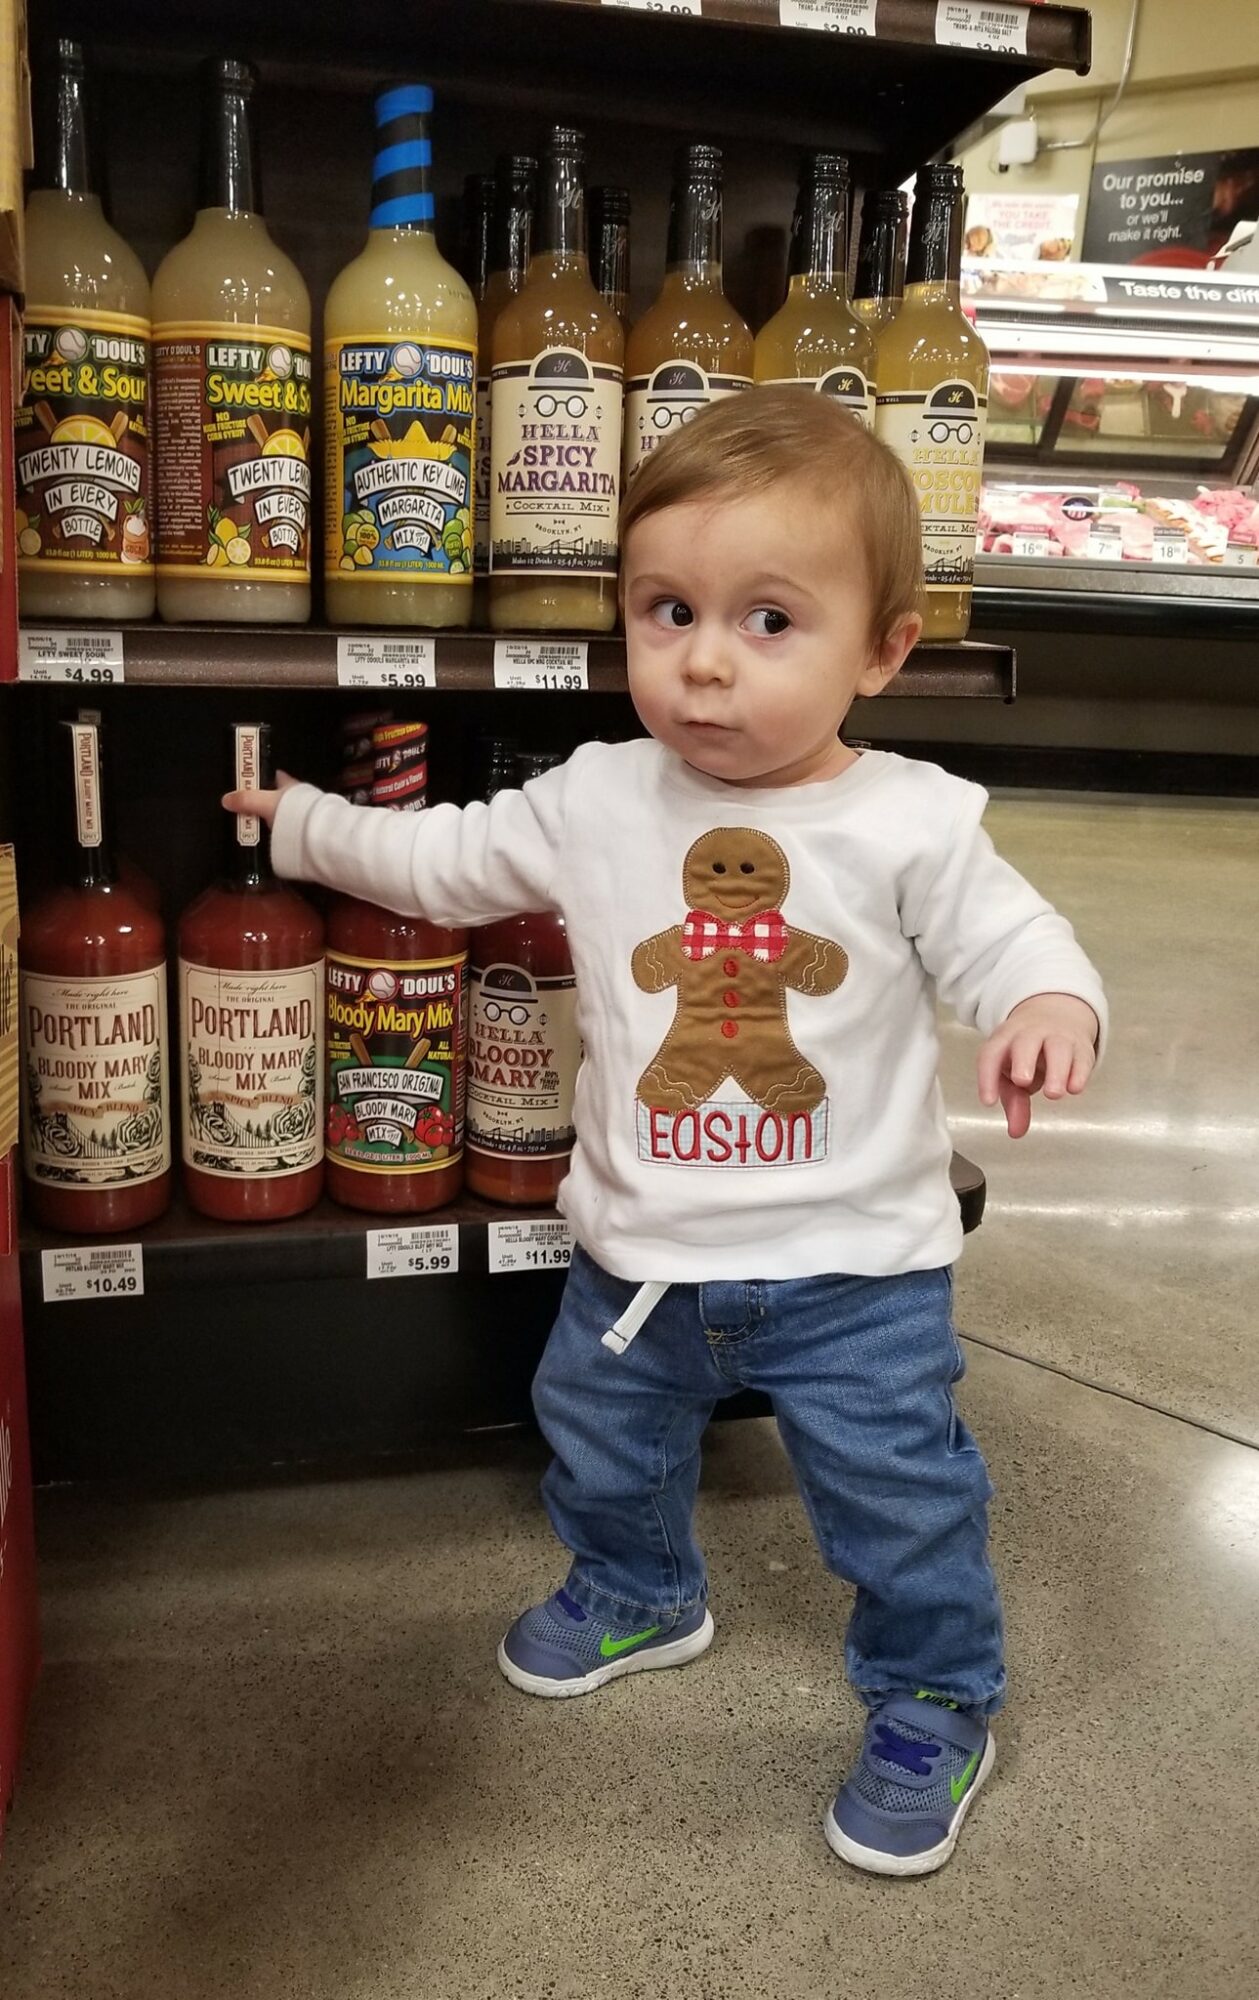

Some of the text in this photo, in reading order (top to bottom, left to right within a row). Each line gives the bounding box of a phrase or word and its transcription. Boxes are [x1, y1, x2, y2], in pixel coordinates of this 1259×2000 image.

[1102, 167, 1205, 191] Our promise
[1120, 192, 1184, 211] to you...
[1126, 211, 1168, 225] or we'll
[1107, 226, 1182, 242] make it right.
[1118, 281, 1181, 299] Taste
[1184, 286, 1221, 301] the
[208, 347, 261, 369] LEFTY
[341, 352, 385, 371] LEFTY
[24, 365, 146, 400] eet & Sour
[208, 374, 298, 412] Sweet &
[341, 379, 473, 414] Margarita Mix
[521, 424, 601, 442] HELLA
[20, 447, 138, 486] TWENTY LEMONS
[523, 445, 597, 467] SPICY
[229, 460, 284, 490] TWENTY
[356, 462, 465, 496] AUTHENTIC KEY LIME
[498, 471, 616, 496] MARGARITA
[48, 484, 116, 511] IN EVERY
[258, 495, 305, 522] IN EVERY
[513, 500, 575, 511] COCKTAIL
[382, 498, 442, 525] MARGARITA
[64, 518, 100, 536] BOTTLE
[272, 527, 298, 545] BOTTLE
[395, 529, 415, 544] MIX
[1022, 543, 1035, 555] 16
[1160, 546, 1174, 559] 18
[65, 667, 114, 682] $4.99
[381, 673, 426, 687] $5.99
[535, 674, 582, 689] $11.99
[78, 732, 94, 777] PORTLAND
[240, 735, 255, 778] PORTLAND
[328, 967, 361, 992] LEFTY
[81, 1002, 116, 1010] ORIGINAL
[241, 995, 275, 1003] ORIGINAL
[191, 997, 312, 1042] PORTLAND
[328, 994, 454, 1038] Bloody Mary Mix
[28, 1004, 155, 1051] PORTLAND
[474, 1021, 545, 1045] HELLA
[198, 1047, 304, 1071] BLOODY MARY
[467, 1037, 554, 1069] BLOODY
[38, 1054, 149, 1079] BLOODY MARY
[473, 1060, 540, 1089] MARY
[78, 1081, 111, 1100] MIX
[236, 1073, 267, 1090] MIX
[339, 1071, 440, 1095] SAN FRANCISCO ORIGINAL
[106, 1102, 139, 1112] BLEND
[262, 1094, 294, 1103] BLEND
[356, 1101, 416, 1126] BLOODY MARY
[368, 1127, 387, 1139] MIX
[649, 1105, 813, 1164] Easton
[408, 1255, 450, 1271] $5.99
[526, 1249, 571, 1264] $11.99
[86, 1276, 137, 1293] $10.49
